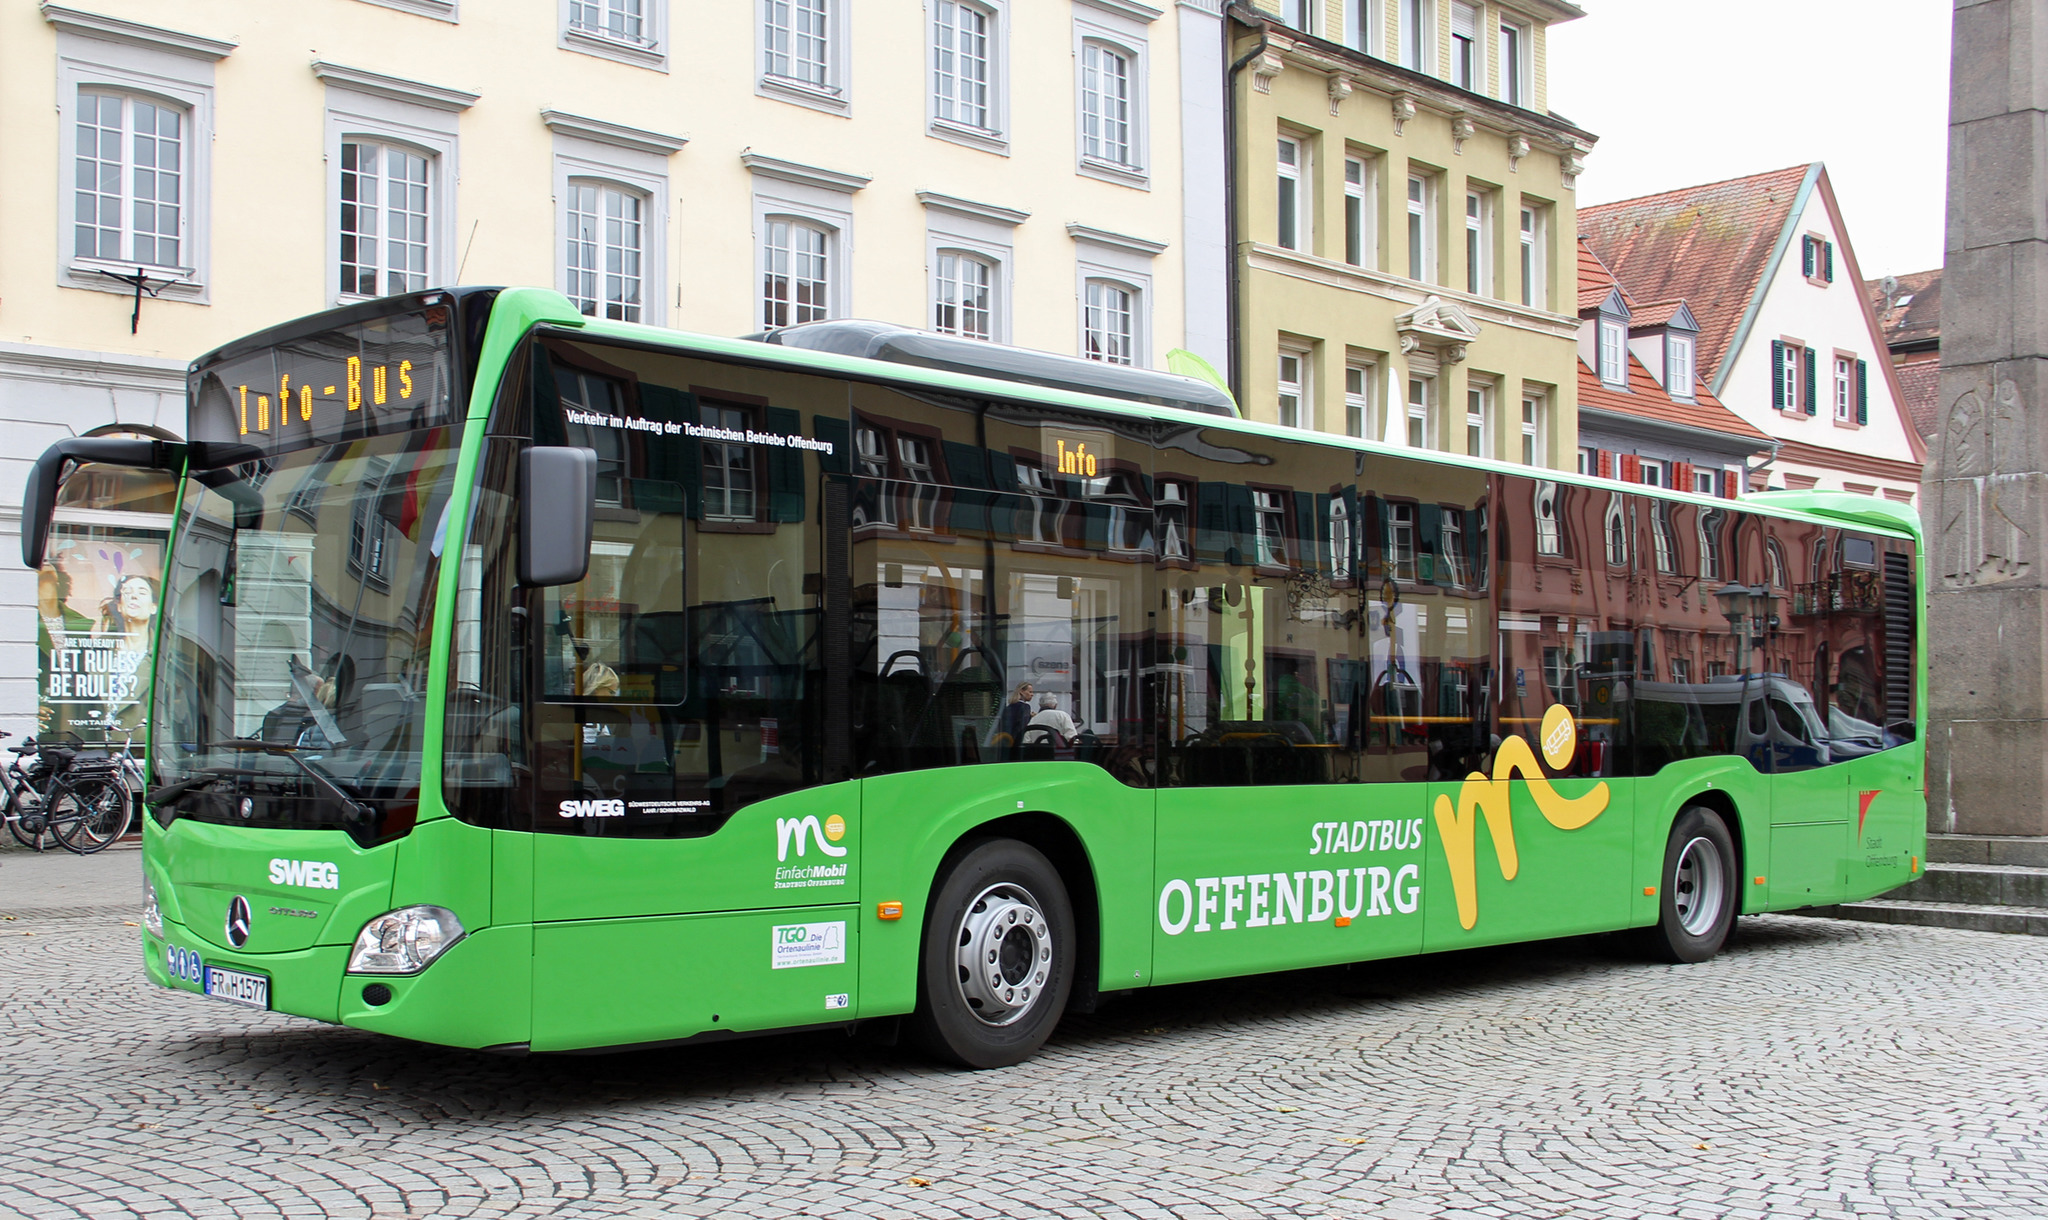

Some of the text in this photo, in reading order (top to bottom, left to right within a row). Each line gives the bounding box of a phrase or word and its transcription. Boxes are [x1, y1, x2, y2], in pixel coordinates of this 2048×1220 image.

[239, 355, 413, 435] Info-Bus
[566, 409, 833, 455] Verkehr im Auftrag der Technischen Betriebe Offenburg
[1057, 439, 1097, 477] Info
[64, 637, 125, 649] ARE YOU READY TO
[50, 649, 137, 674] LET RULES
[49, 673, 138, 698] BE RULES?
[559, 799, 625, 818] SWEG
[1309, 819, 1423, 855] STADTBUS
[1866, 837, 1882, 849] Stadt
[775, 863, 848, 880] EinfachMobil
[1866, 854, 1898, 869] Offenburg
[268, 857, 339, 890] SWEG
[1158, 864, 1421, 936] OFFENBURG
[777, 926, 807, 944] TGO
[810, 933, 823, 942] Die
[777, 943, 821, 954] Ortenaulinie
[777, 956, 839, 967] www.ortenaulinie.de
[211, 971, 225, 994] FR
